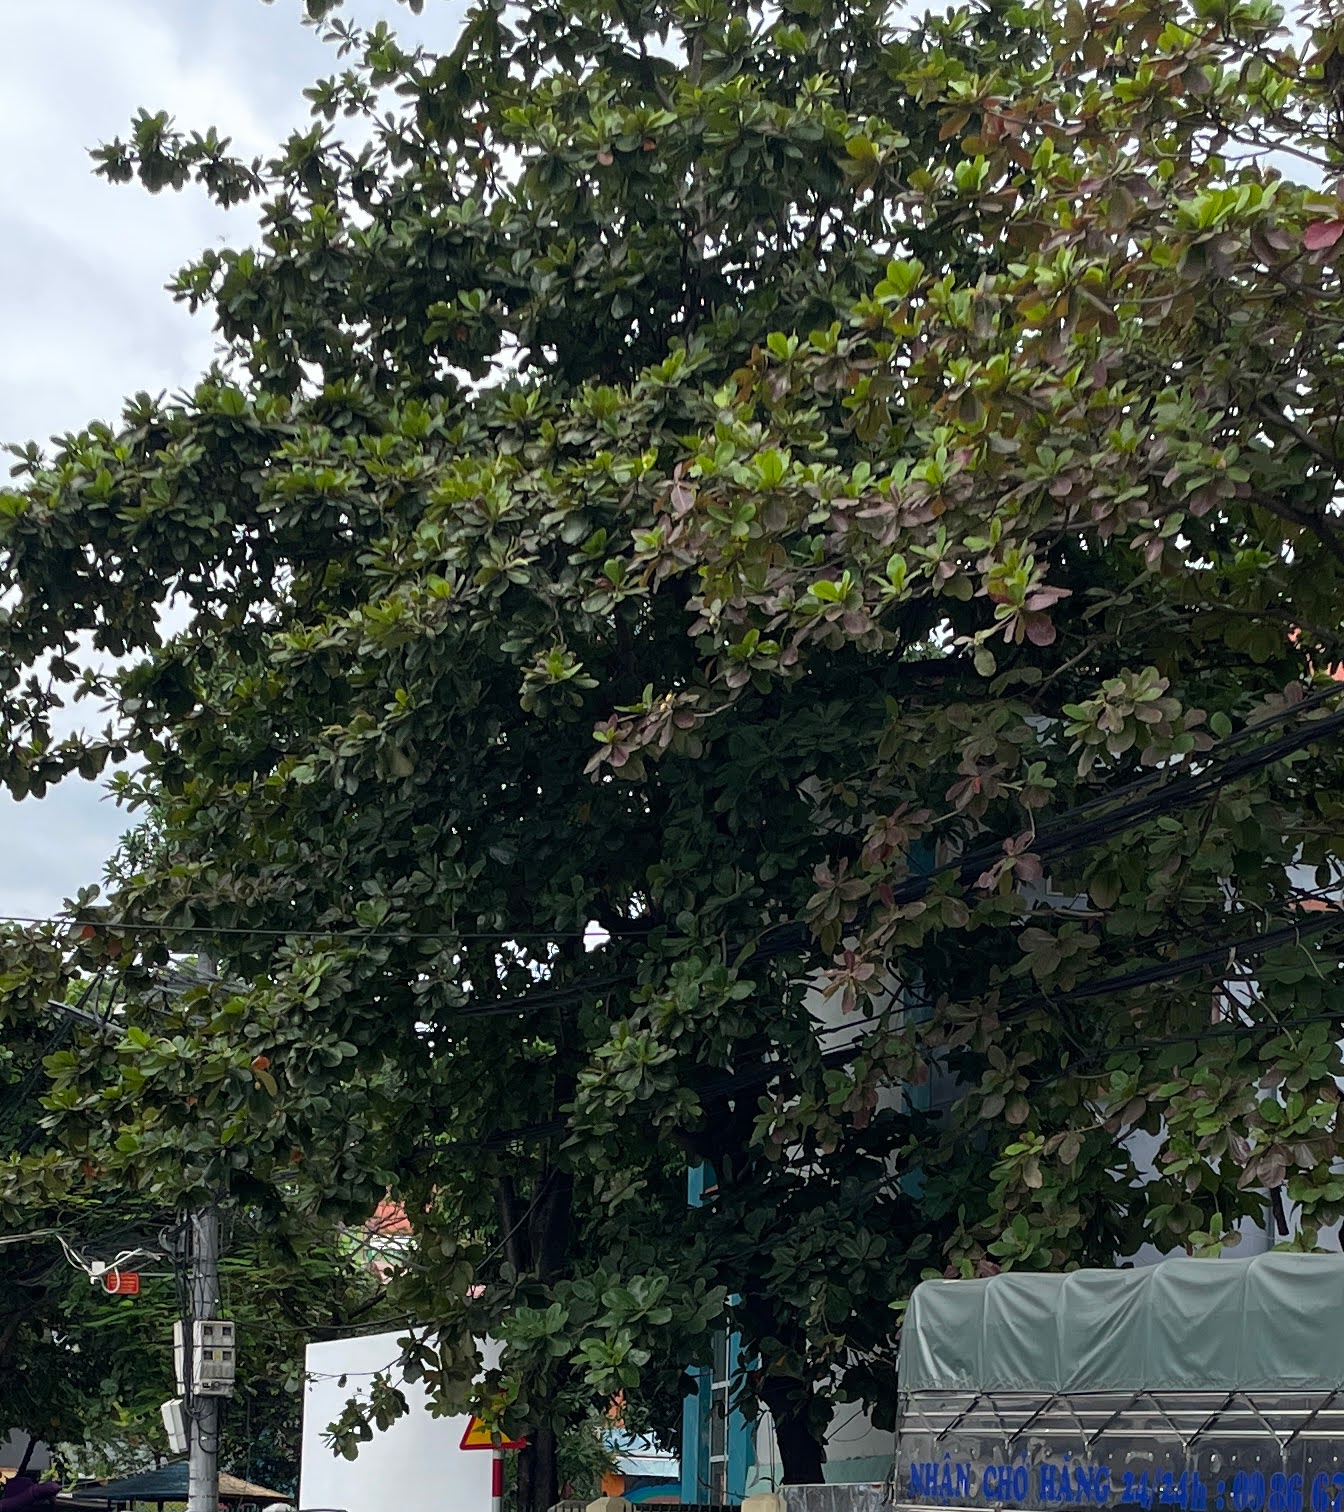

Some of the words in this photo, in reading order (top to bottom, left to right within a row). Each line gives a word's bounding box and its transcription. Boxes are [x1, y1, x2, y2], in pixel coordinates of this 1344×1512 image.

[909, 1452, 972, 1504] NHẬN
[983, 1450, 1030, 1500] CHỞ
[1039, 1453, 1113, 1503] HÀNG
